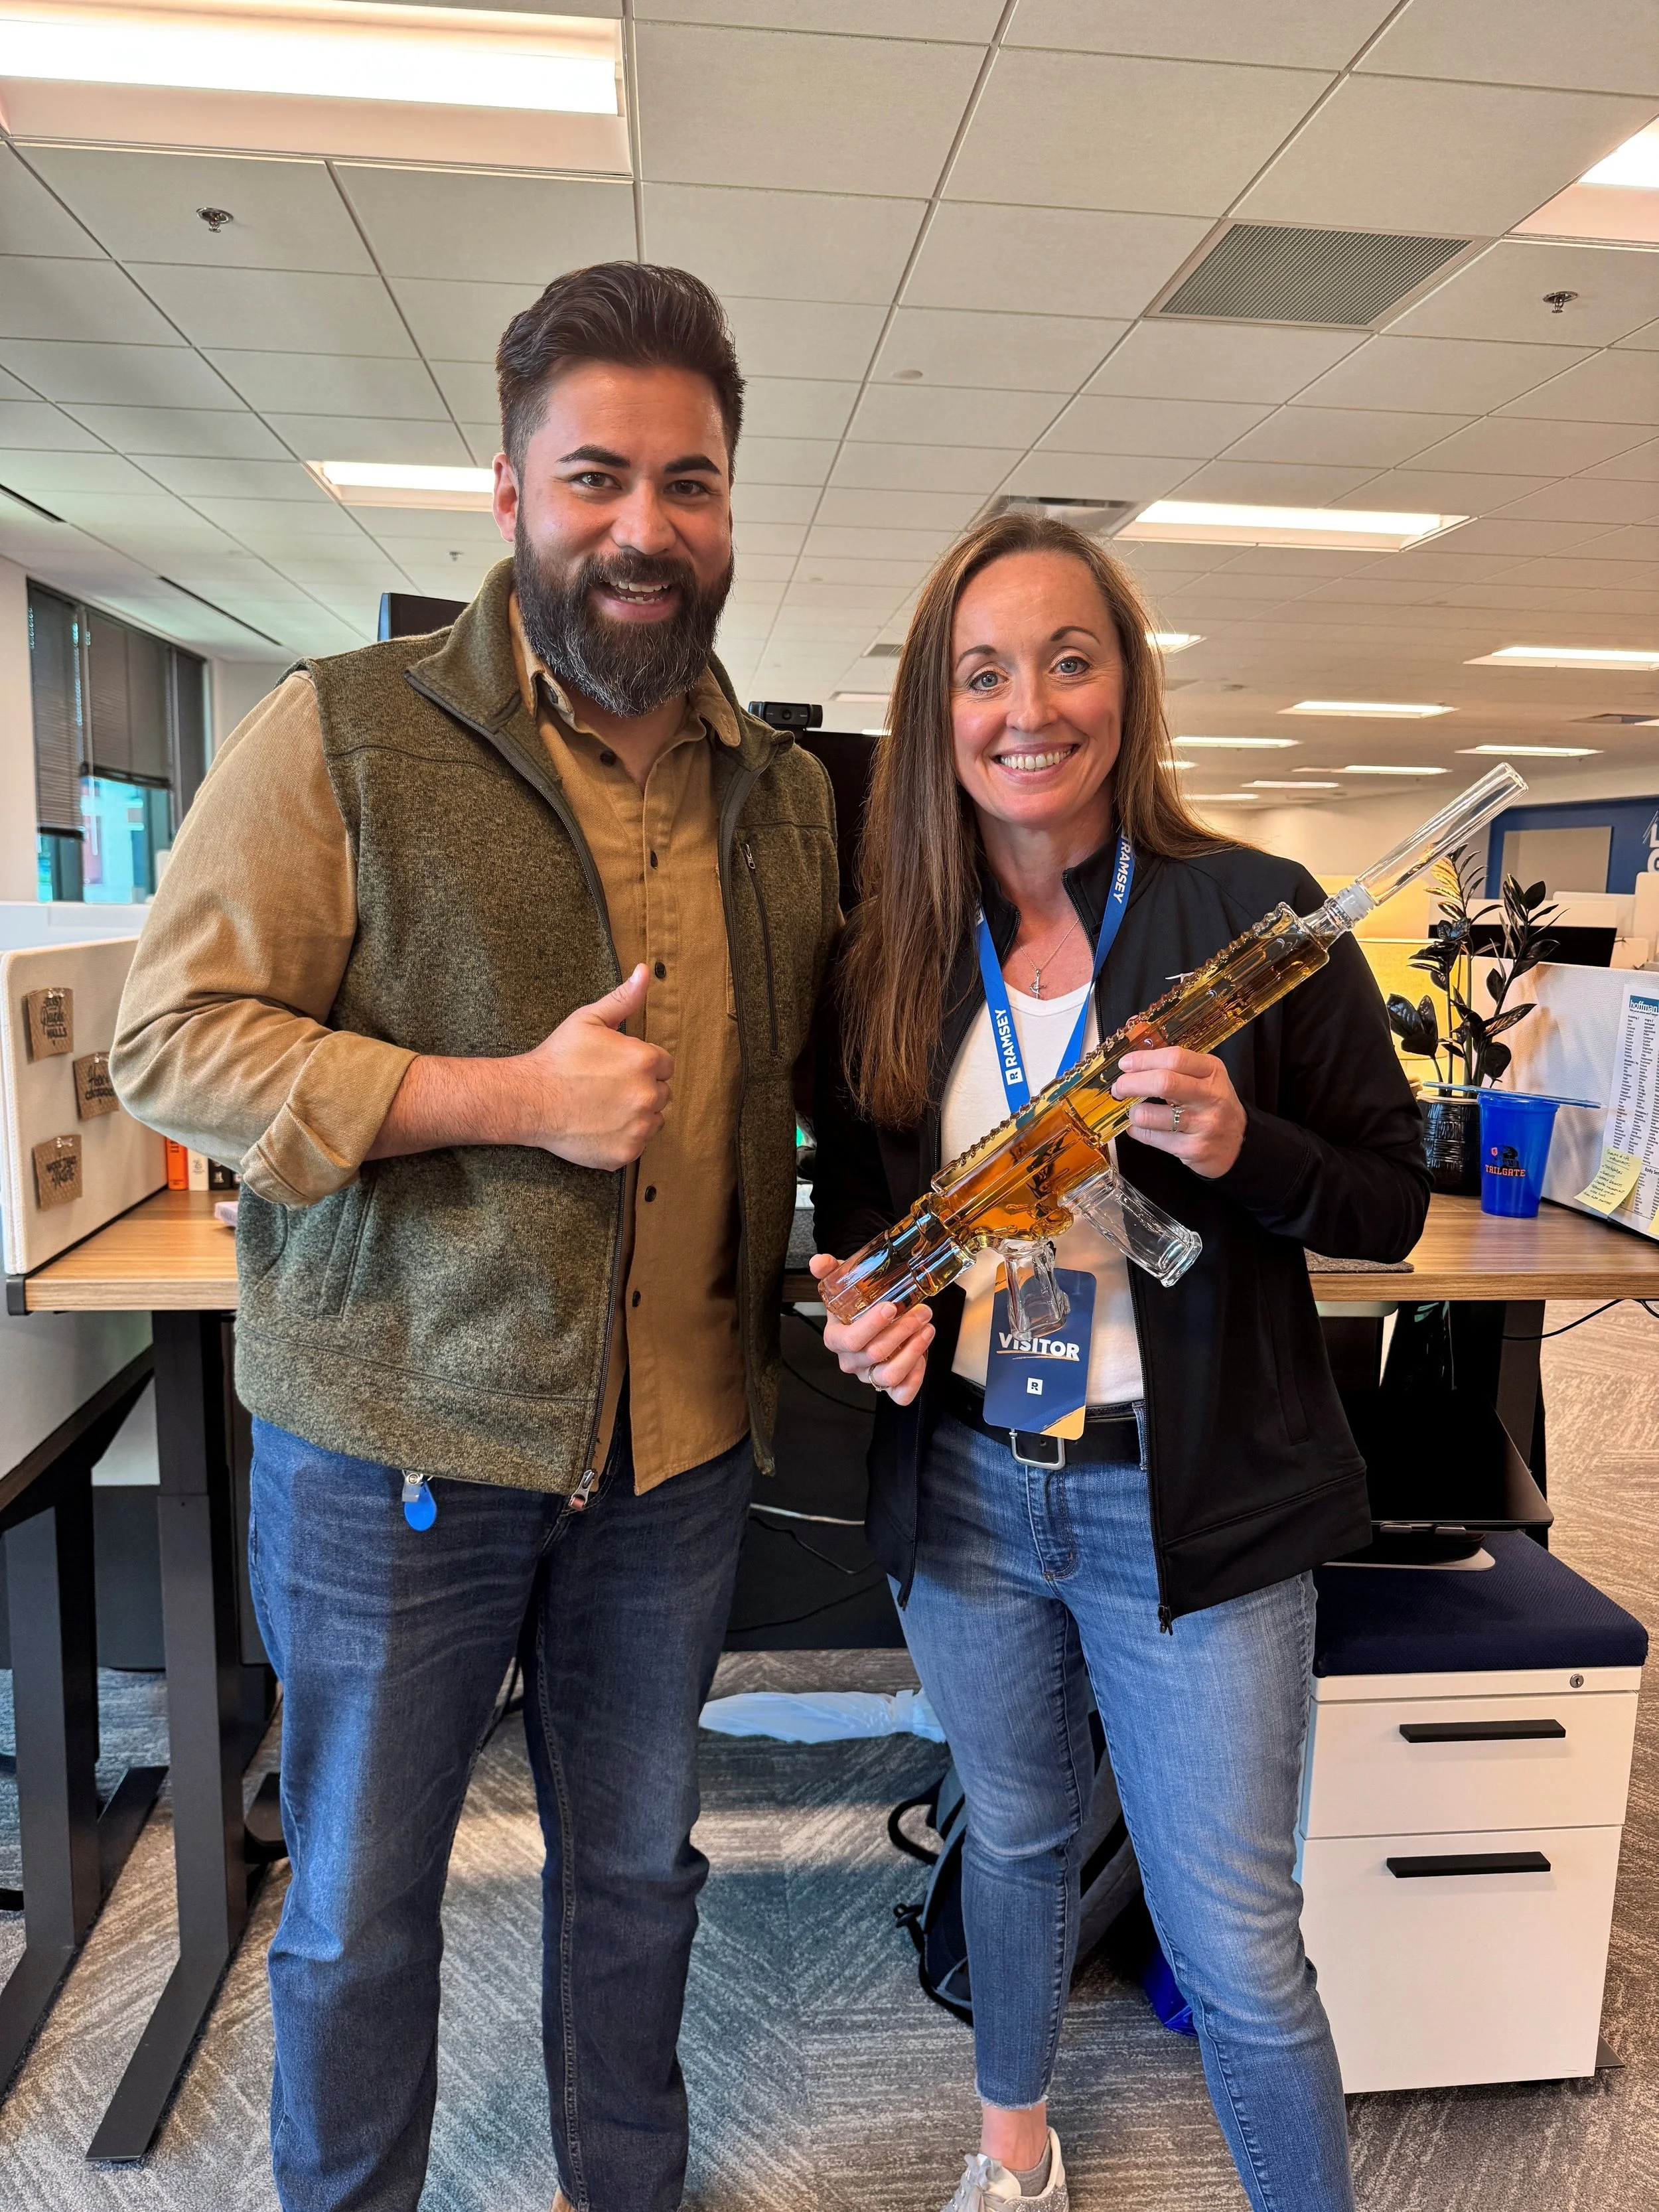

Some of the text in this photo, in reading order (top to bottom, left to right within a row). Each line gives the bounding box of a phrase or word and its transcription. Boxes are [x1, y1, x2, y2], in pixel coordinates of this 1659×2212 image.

[1113, 841, 1131, 904] RAMSEY
[1630, 999, 1658, 1013] hoffman
[995, 1009, 1018, 1068] RAMSEY
[1485, 1164, 1526, 1177] TAILGATE
[999, 1332, 1080, 1362] VISITOR
